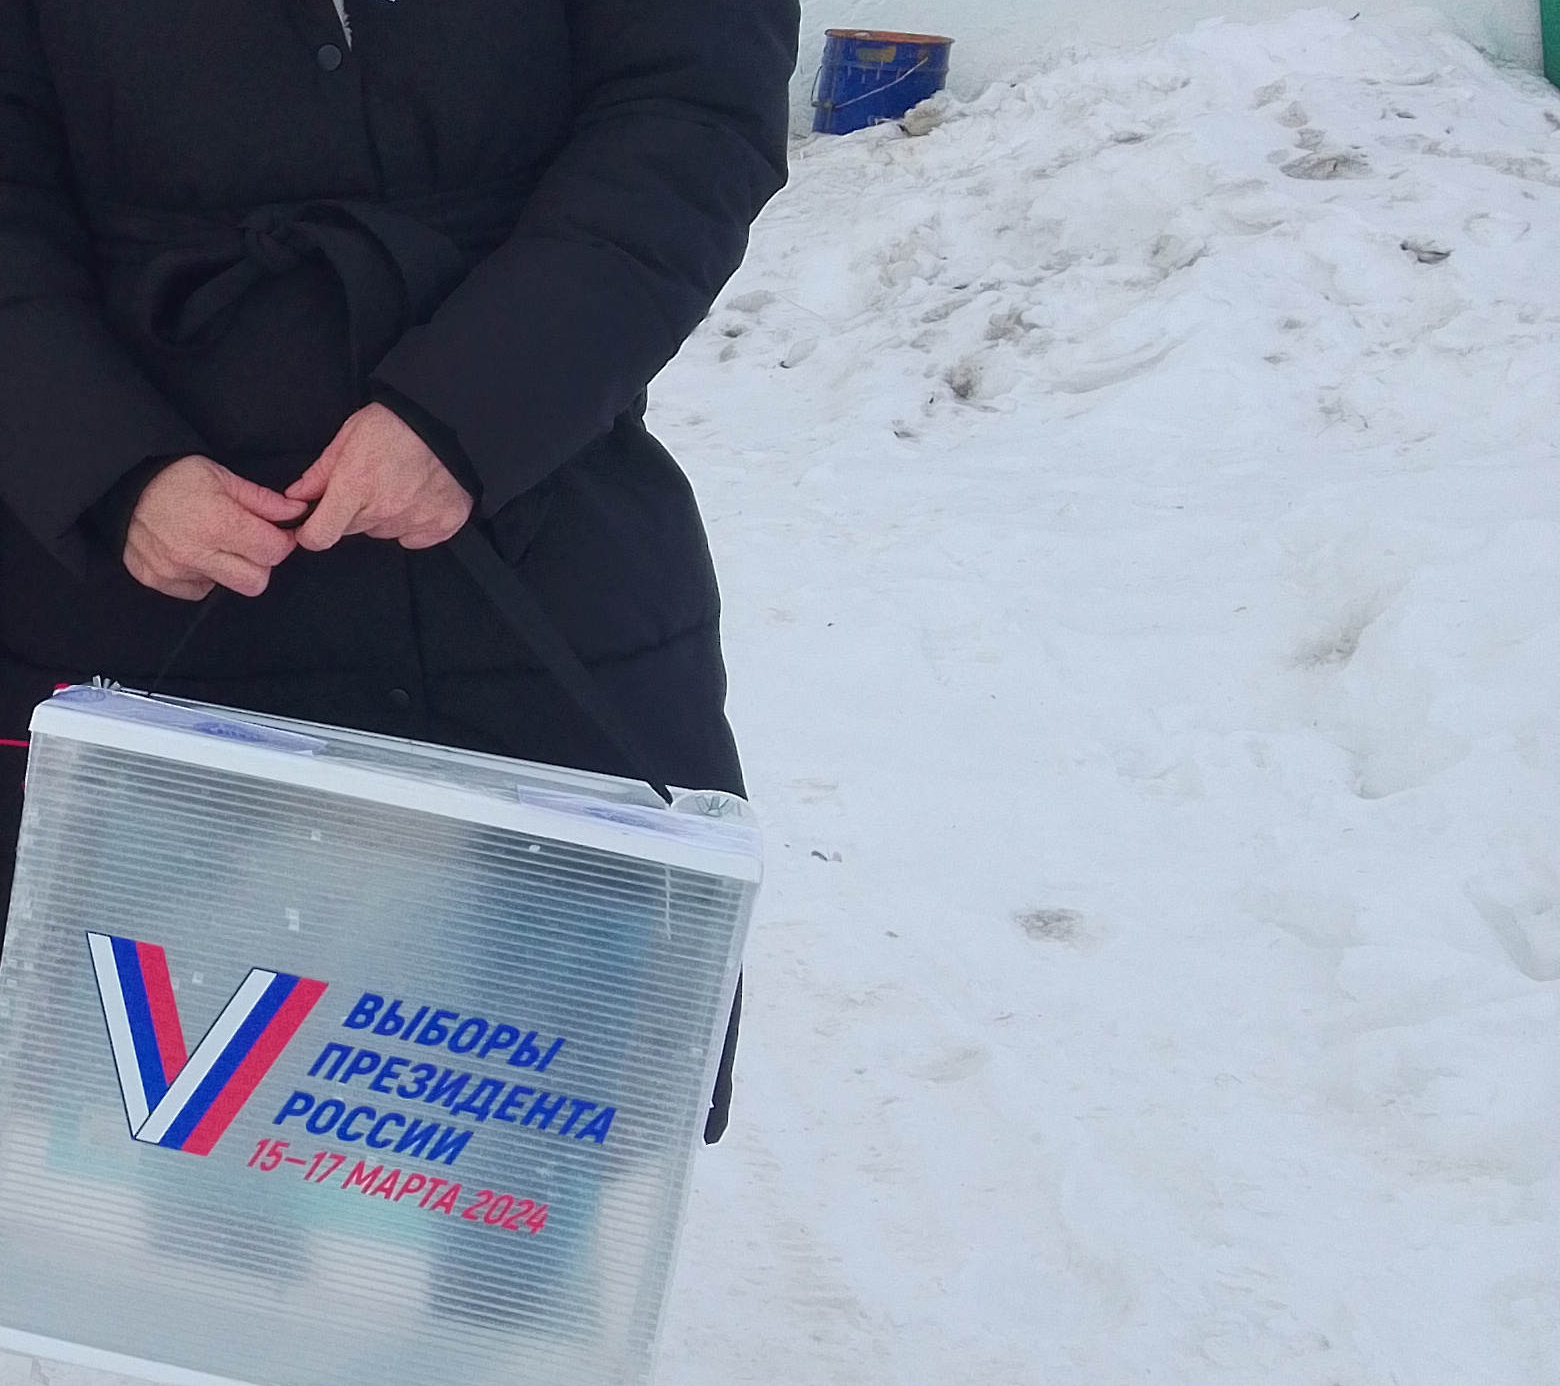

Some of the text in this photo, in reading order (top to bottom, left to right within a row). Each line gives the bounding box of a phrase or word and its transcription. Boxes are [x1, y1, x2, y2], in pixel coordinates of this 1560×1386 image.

[342, 992, 566, 1072] ВЫБОРЫ
[273, 1090, 474, 1165] РОССИИ
[307, 1041, 619, 1145] ПРЕЗИДЕНТА
[342, 1160, 464, 1215] МАРТА
[461, 1189, 549, 1235] 2024
